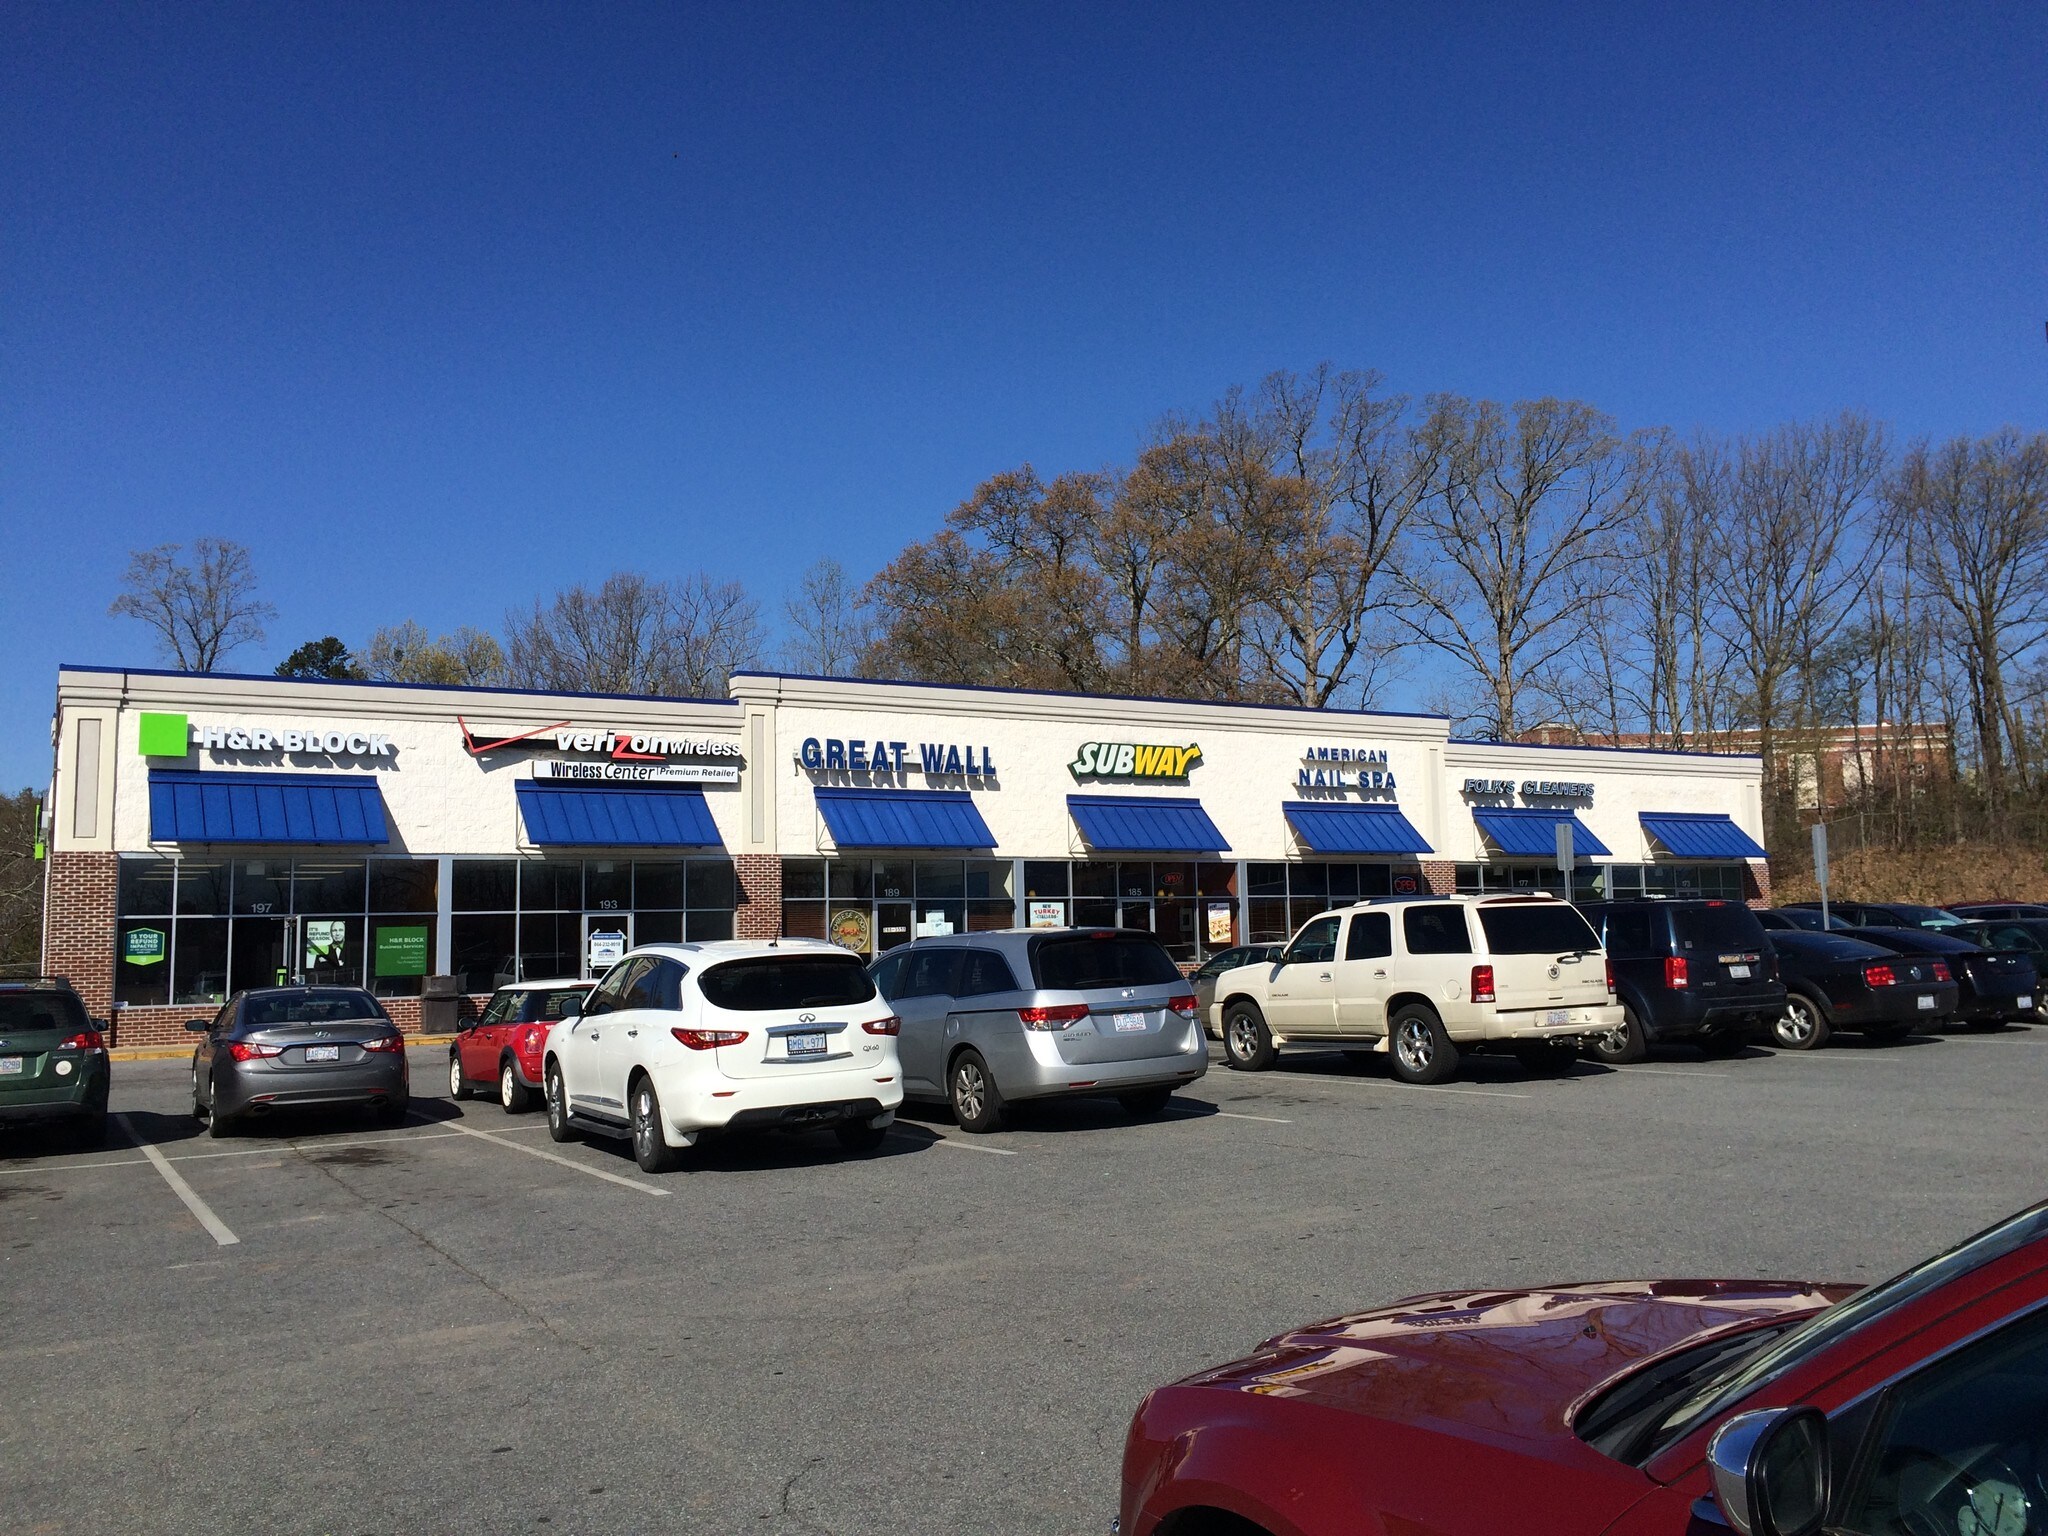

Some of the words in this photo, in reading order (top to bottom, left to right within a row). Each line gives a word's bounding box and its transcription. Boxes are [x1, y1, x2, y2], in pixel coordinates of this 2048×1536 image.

[203, 726, 274, 751] H&R
[283, 729, 390, 756] BLOCK
[801, 737, 908, 772] GREAT
[919, 742, 997, 776] WALL
[1072, 741, 1201, 777] SUBWAY
[1306, 746, 1388, 763] AMERICAN
[550, 761, 602, 779] Wireless
[604, 762, 655, 780] Center
[659, 767, 700, 777] Premium
[701, 769, 736, 778] Retailer
[1298, 768, 1346, 787] NAIL
[1358, 770, 1397, 789] SPA
[1464, 778, 1516, 795] FOLK'S
[1522, 780, 1596, 797] CLEANERS
[884, 887, 900, 897] 189
[1128, 887, 1142, 897] 185
[250, 902, 273, 914] 197
[599, 899, 618, 910] 193
